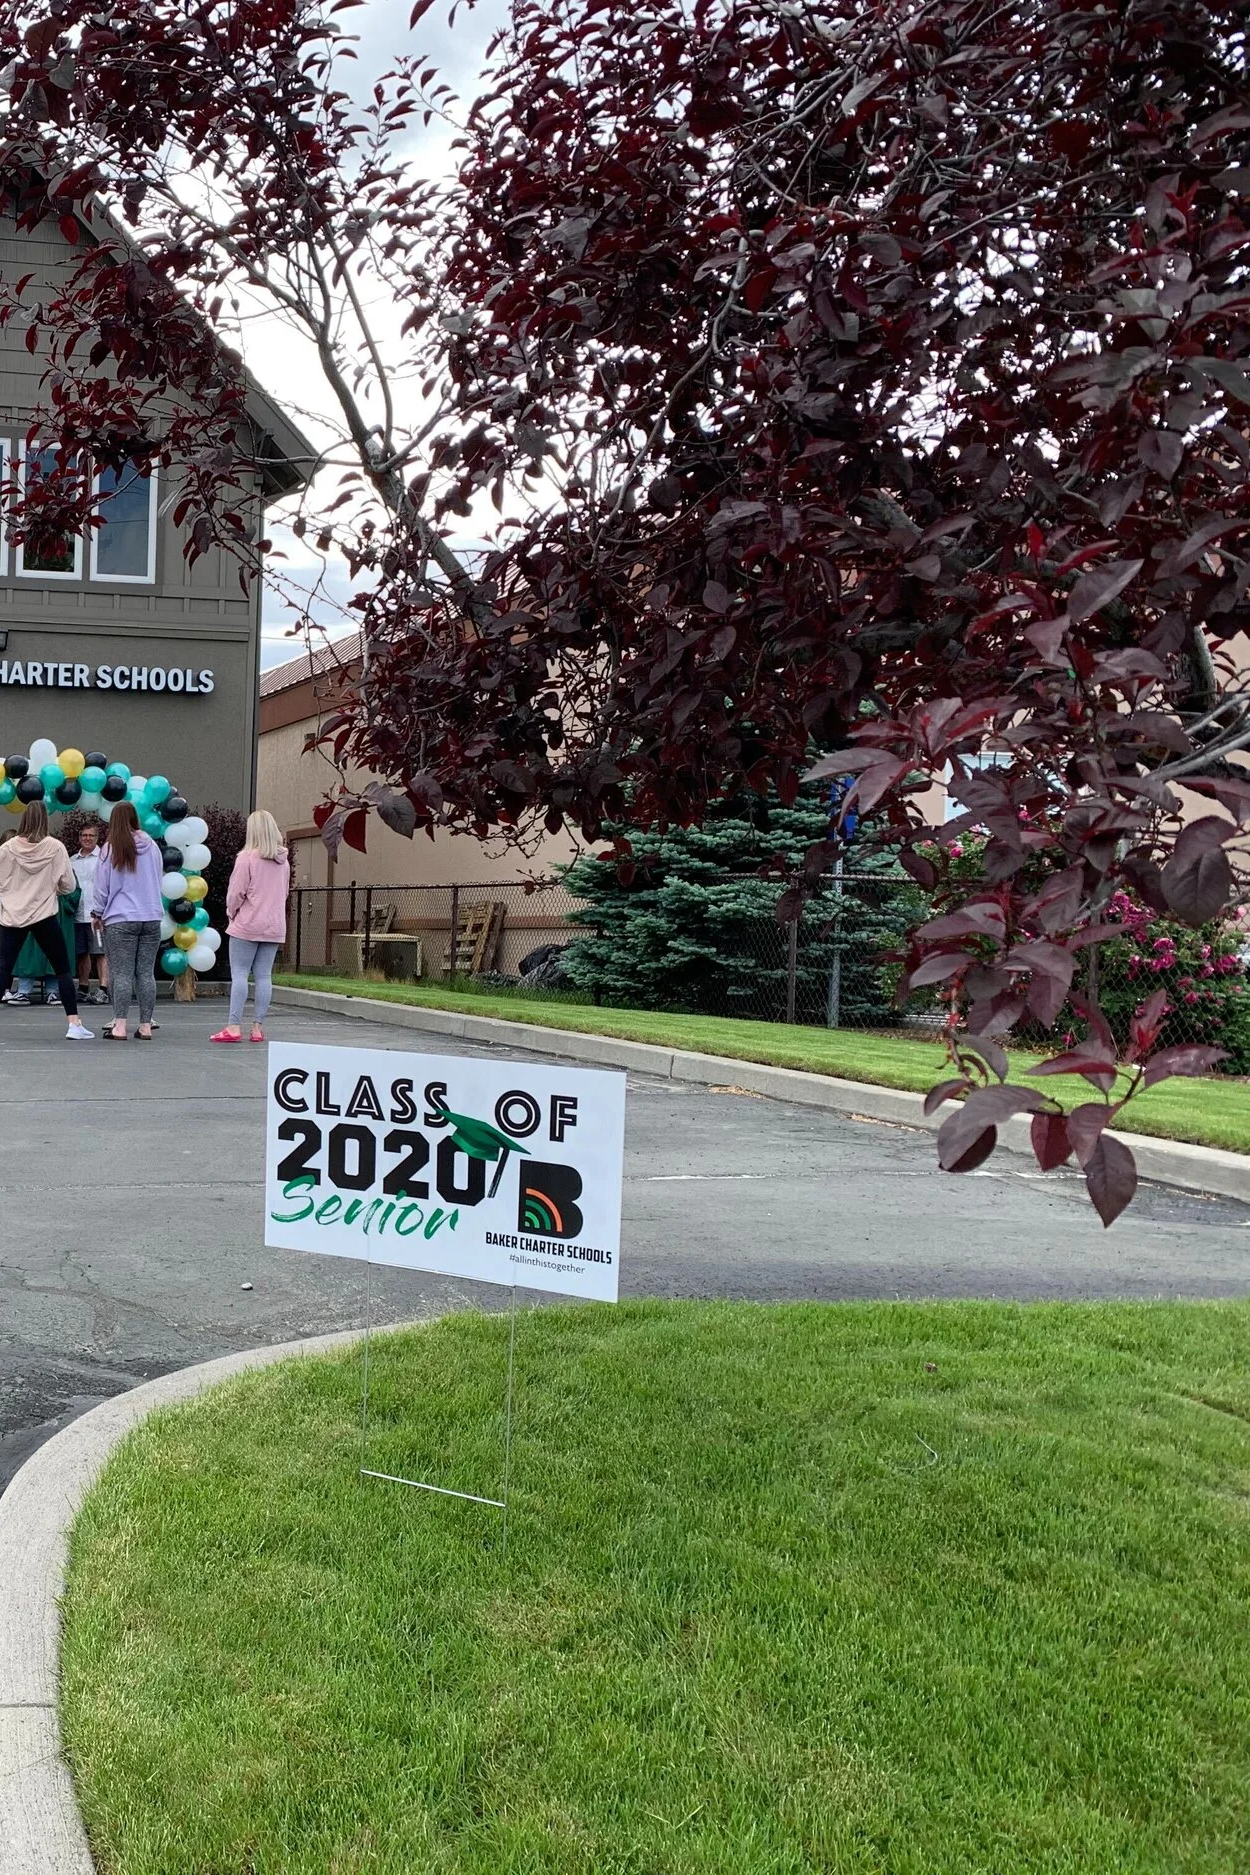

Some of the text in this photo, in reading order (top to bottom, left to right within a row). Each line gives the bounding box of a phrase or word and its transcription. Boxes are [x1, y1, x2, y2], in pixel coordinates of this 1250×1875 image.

[95, 664, 215, 694] SCHOOLS
[274, 1068, 578, 1143] CLASS OF
[277, 1117, 487, 1207] 2020
[271, 1174, 459, 1240] Senior
[485, 1231, 612, 1265] BAKER CHARTER SCHOOLS
[509, 1253, 586, 1274] #allinthistogether
